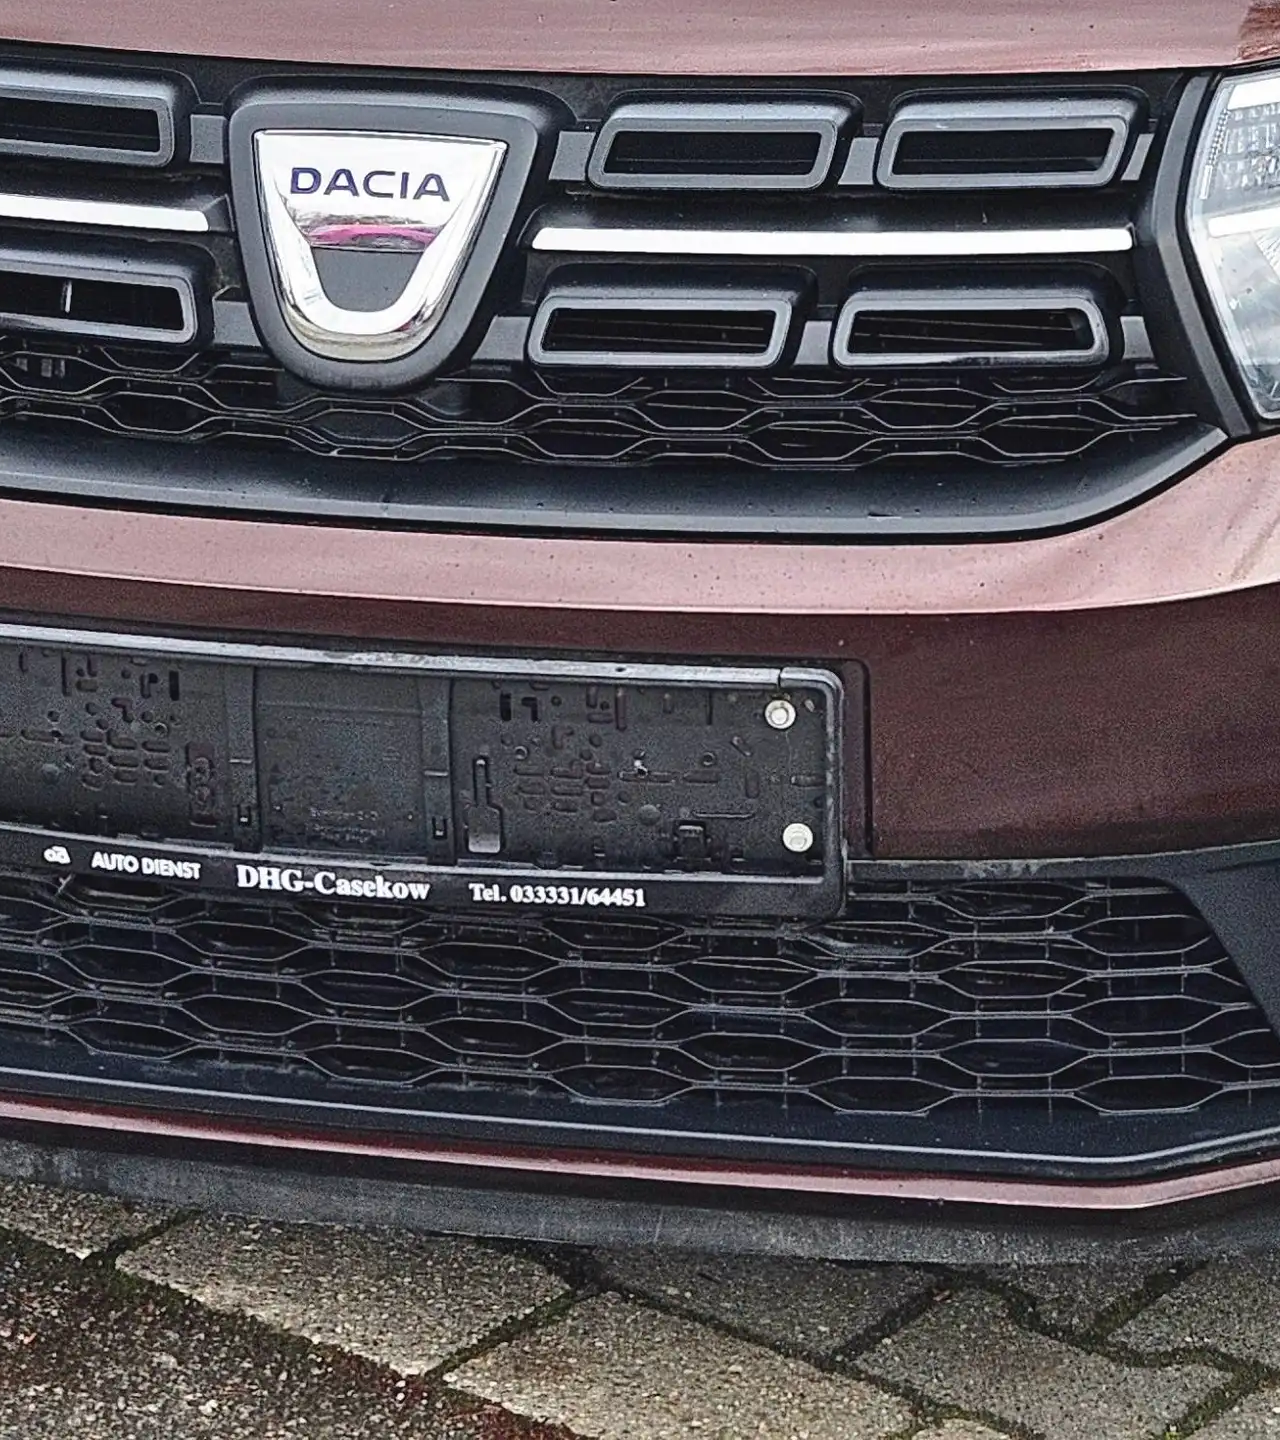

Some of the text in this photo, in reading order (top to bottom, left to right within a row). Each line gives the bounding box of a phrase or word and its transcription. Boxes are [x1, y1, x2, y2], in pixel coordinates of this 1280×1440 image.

[290, 166, 450, 202] DACIA
[91, 851, 201, 879] AUTO DIENST
[236, 864, 430, 900] DHG-Casekow
[468, 883, 646, 907] Tel. 033331/64451
